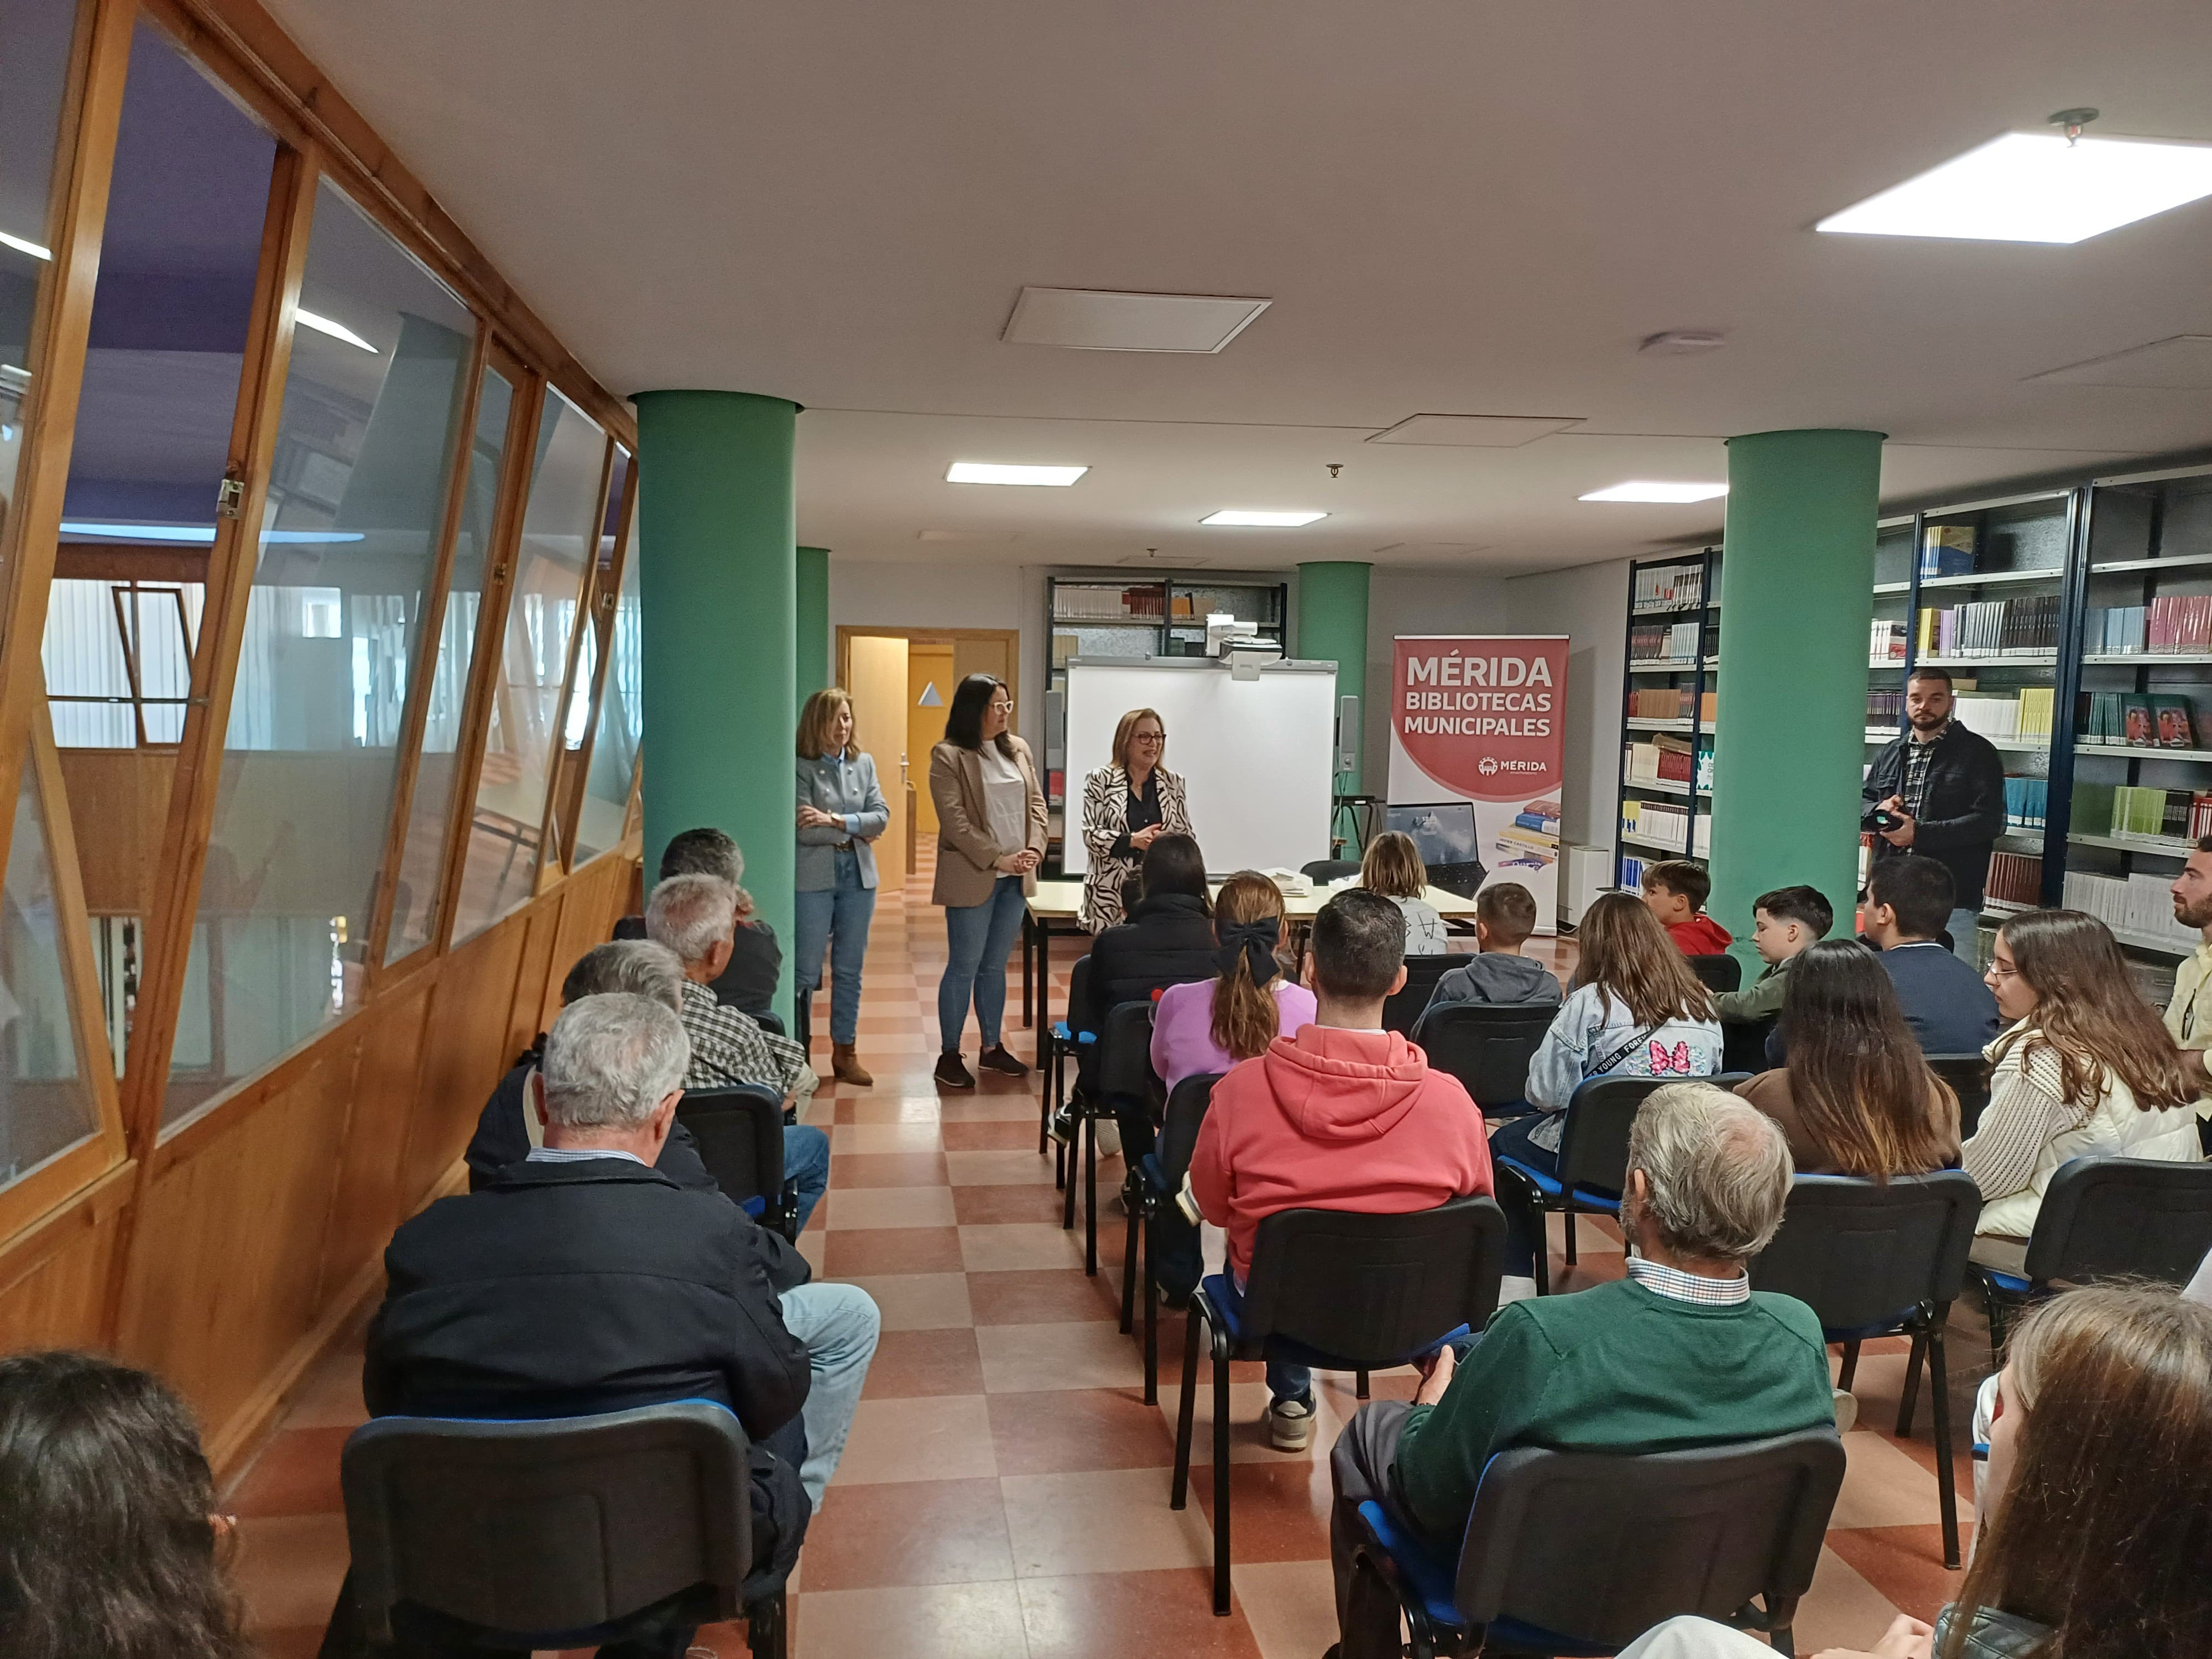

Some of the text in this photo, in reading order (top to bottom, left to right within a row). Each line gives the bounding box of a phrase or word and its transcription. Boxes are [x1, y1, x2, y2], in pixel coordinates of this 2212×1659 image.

[1407, 649, 1553, 687] MÉRIDA
[1405, 692, 1551, 712] BIBLIOTECAS
[1404, 716, 1550, 737] MUNICIPALES
[1500, 760, 1547, 772] MÉRIDA
[1514, 841, 1534, 850] CASTILLO
[1597, 1052, 1622, 1073] YOUNG
